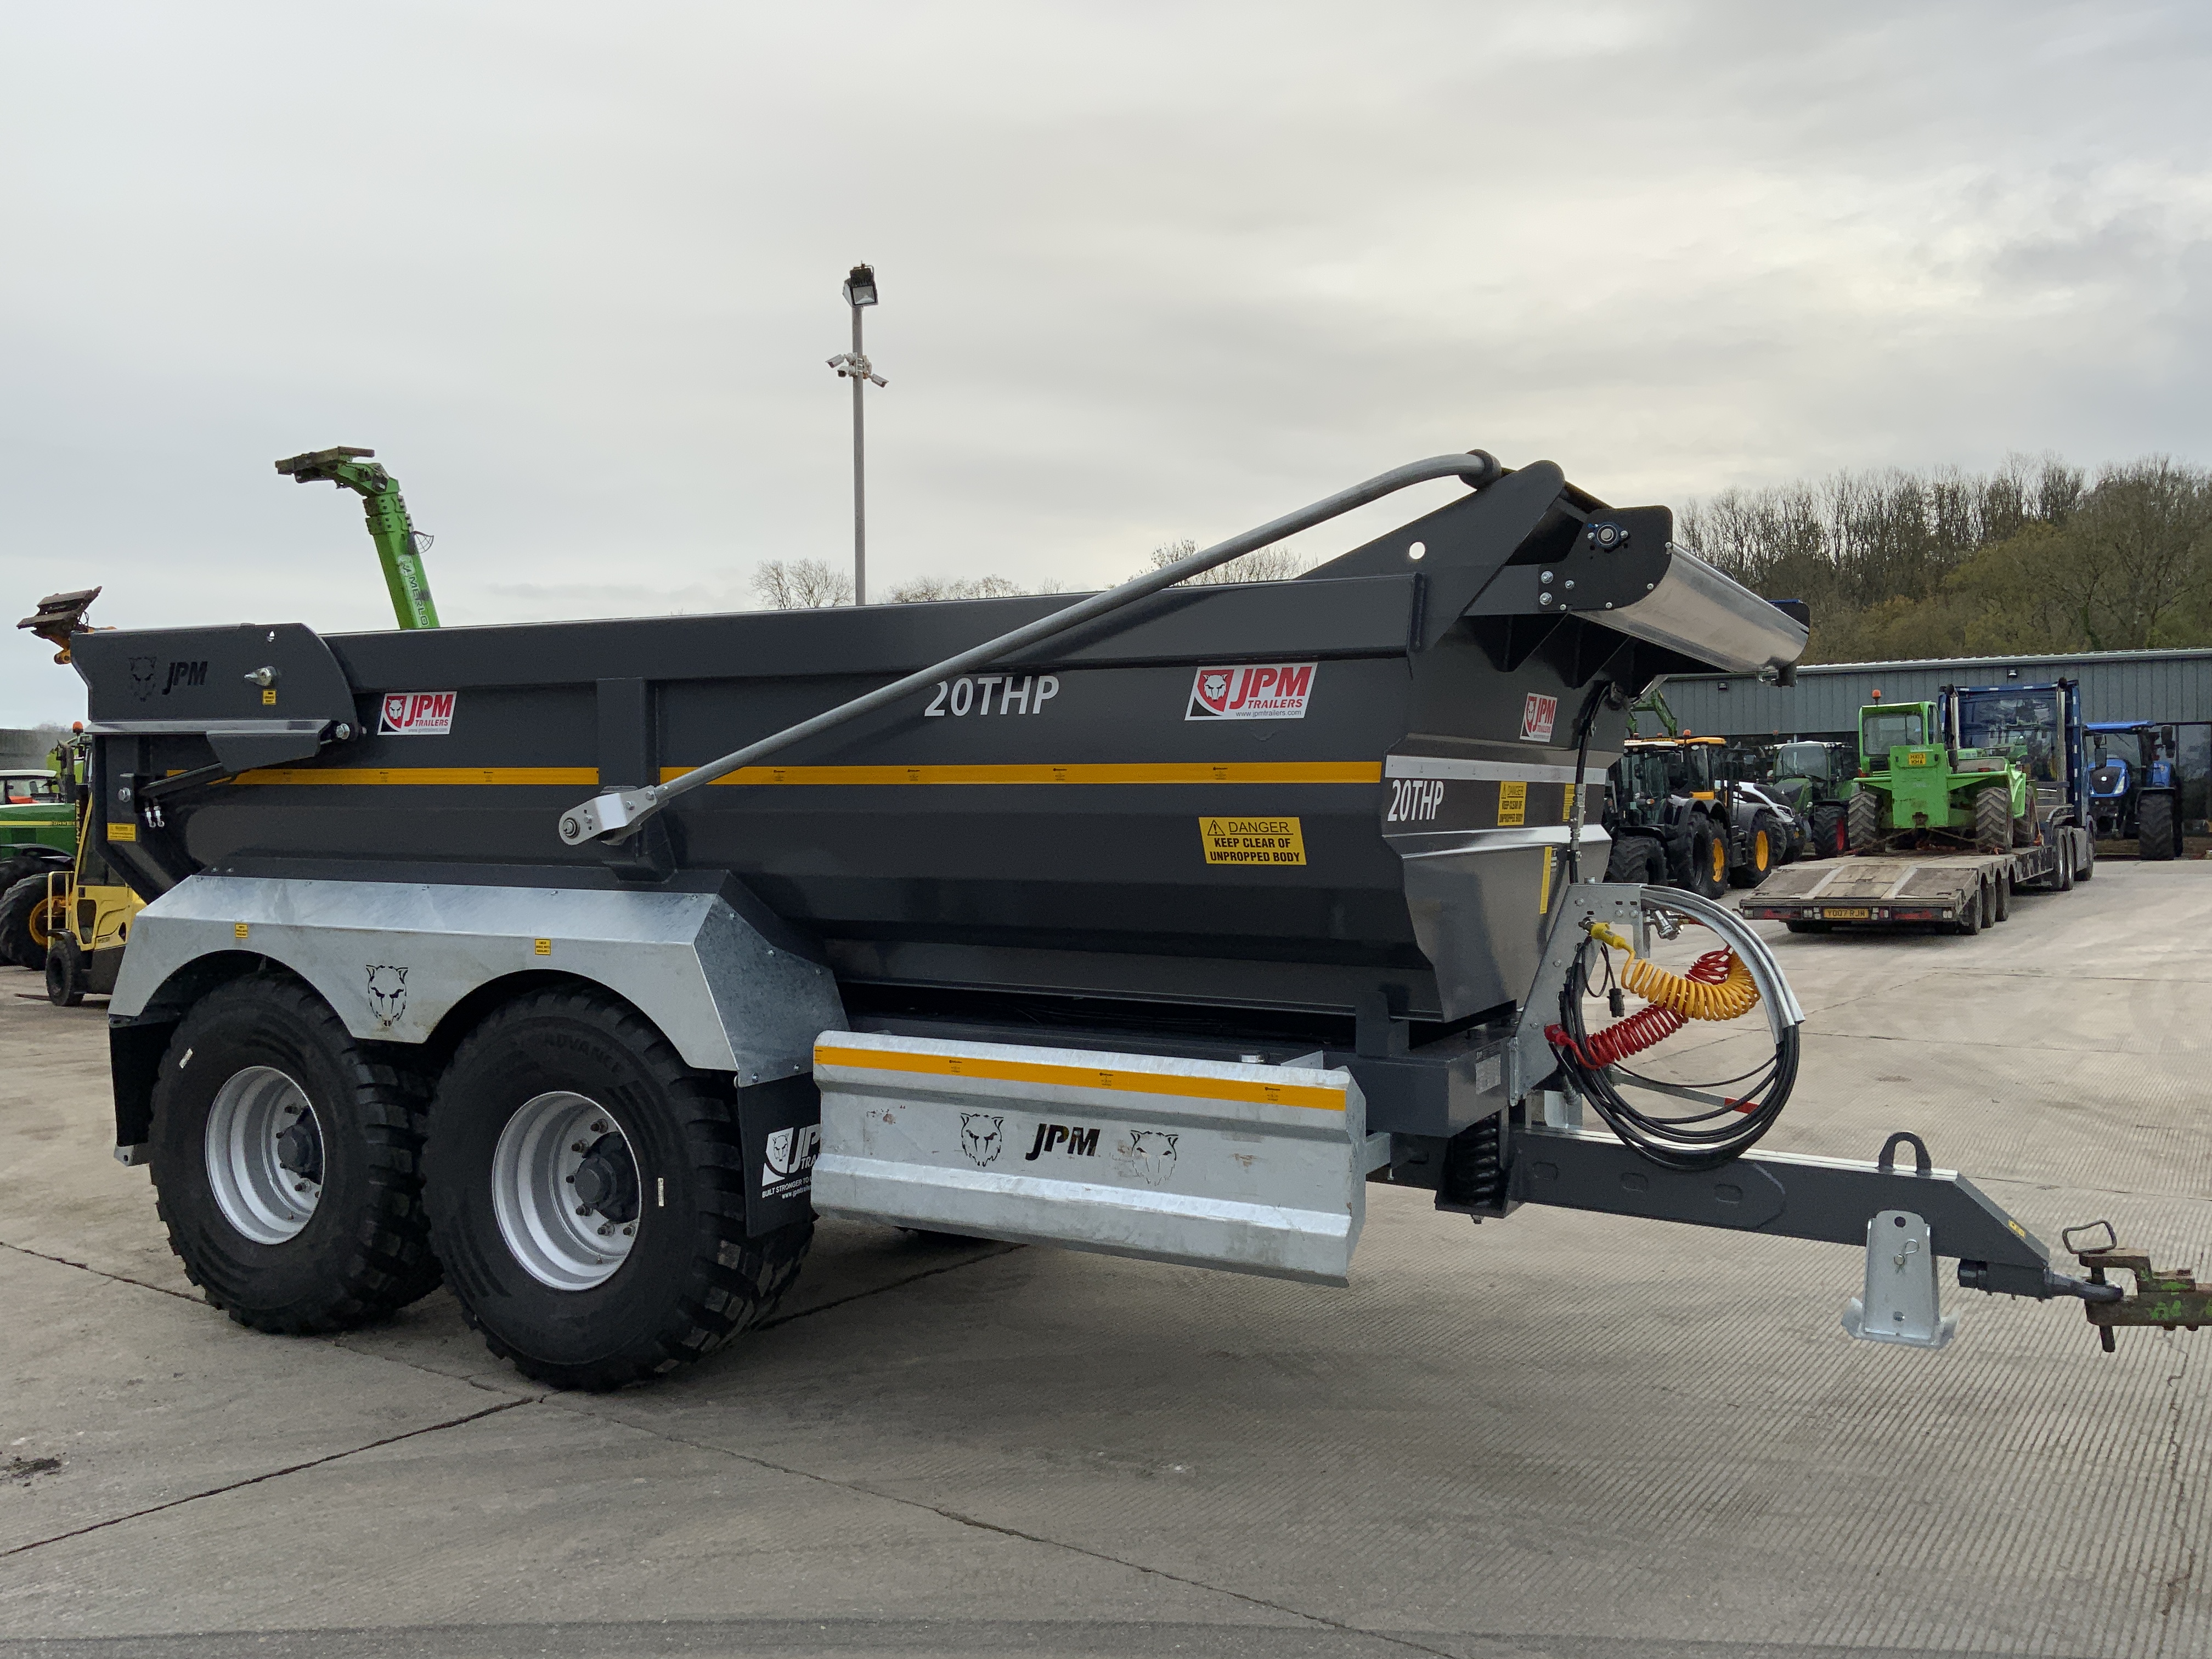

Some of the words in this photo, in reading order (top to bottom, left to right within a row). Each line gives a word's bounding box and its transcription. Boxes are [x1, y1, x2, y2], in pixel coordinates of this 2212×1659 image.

[409, 576, 429, 626] MERLO
[162, 661, 208, 695] JPM
[1229, 666, 1312, 709] JPM
[404, 694, 454, 727] JPM
[924, 675, 1059, 716] 20THP
[1248, 699, 1303, 709] TRAILERS
[415, 719, 449, 727] TRAILERS
[1532, 697, 1556, 732] JPM
[1387, 779, 1444, 822] 20THP
[1214, 838, 1239, 847] KEEP
[1243, 838, 1276, 848] CLEAR
[1278, 838, 1291, 848] OF
[1228, 821, 1290, 833] DANGER
[1210, 851, 1270, 861] UNPROPPED
[1273, 852, 1300, 862] BODY
[788, 1124, 821, 1174] JP
[1025, 1122, 1101, 1161] JPM
[801, 1154, 816, 1170] TRA
[761, 1187, 776, 1199] BUILT
[776, 1179, 803, 1193] STRONGER
